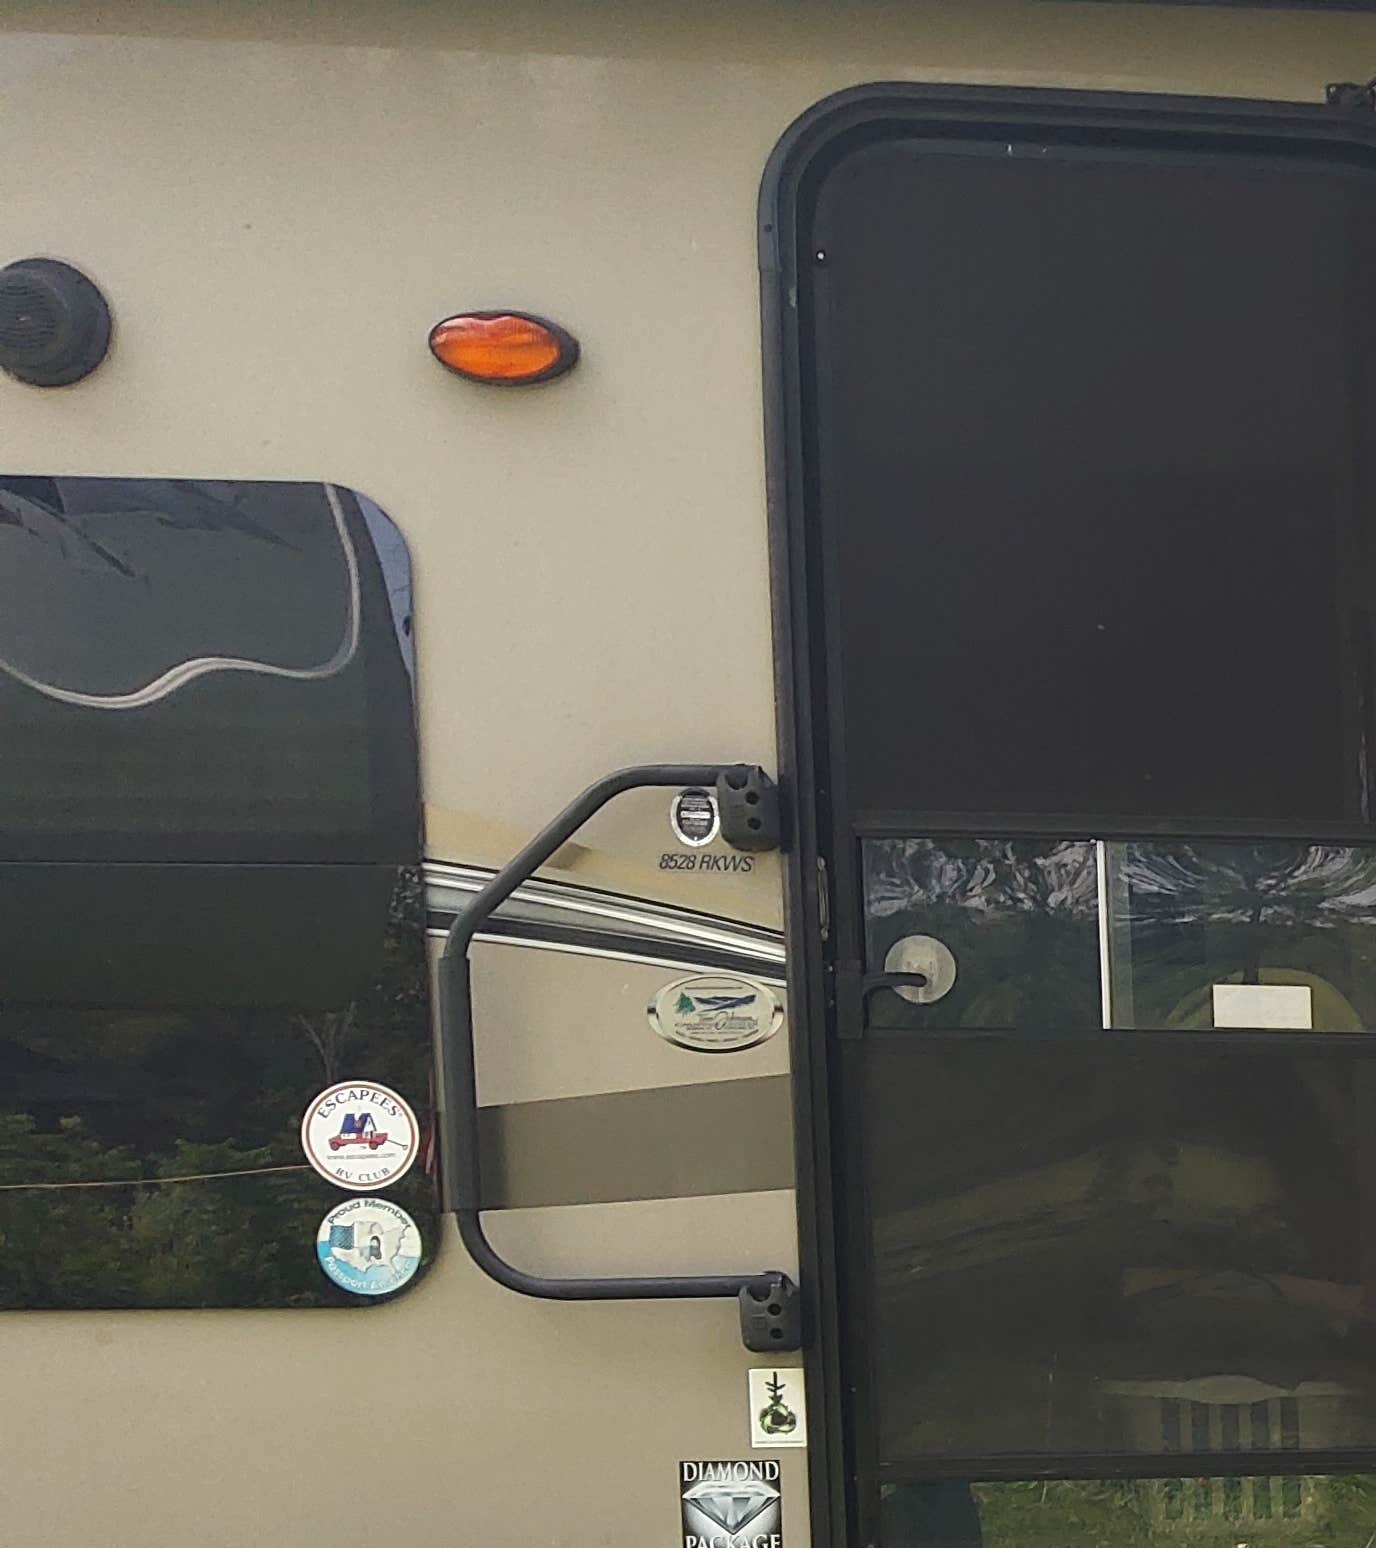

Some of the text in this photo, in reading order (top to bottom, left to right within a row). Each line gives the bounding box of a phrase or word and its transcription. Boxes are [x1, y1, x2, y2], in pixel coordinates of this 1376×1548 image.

[659, 853, 755, 873] 8528 RKWS
[317, 1089, 398, 1119] ESCAPEES
[335, 1167, 391, 1182] RV CLUB
[327, 1199, 411, 1228] Proud Member
[683, 1461, 779, 1482] DIAMOND
